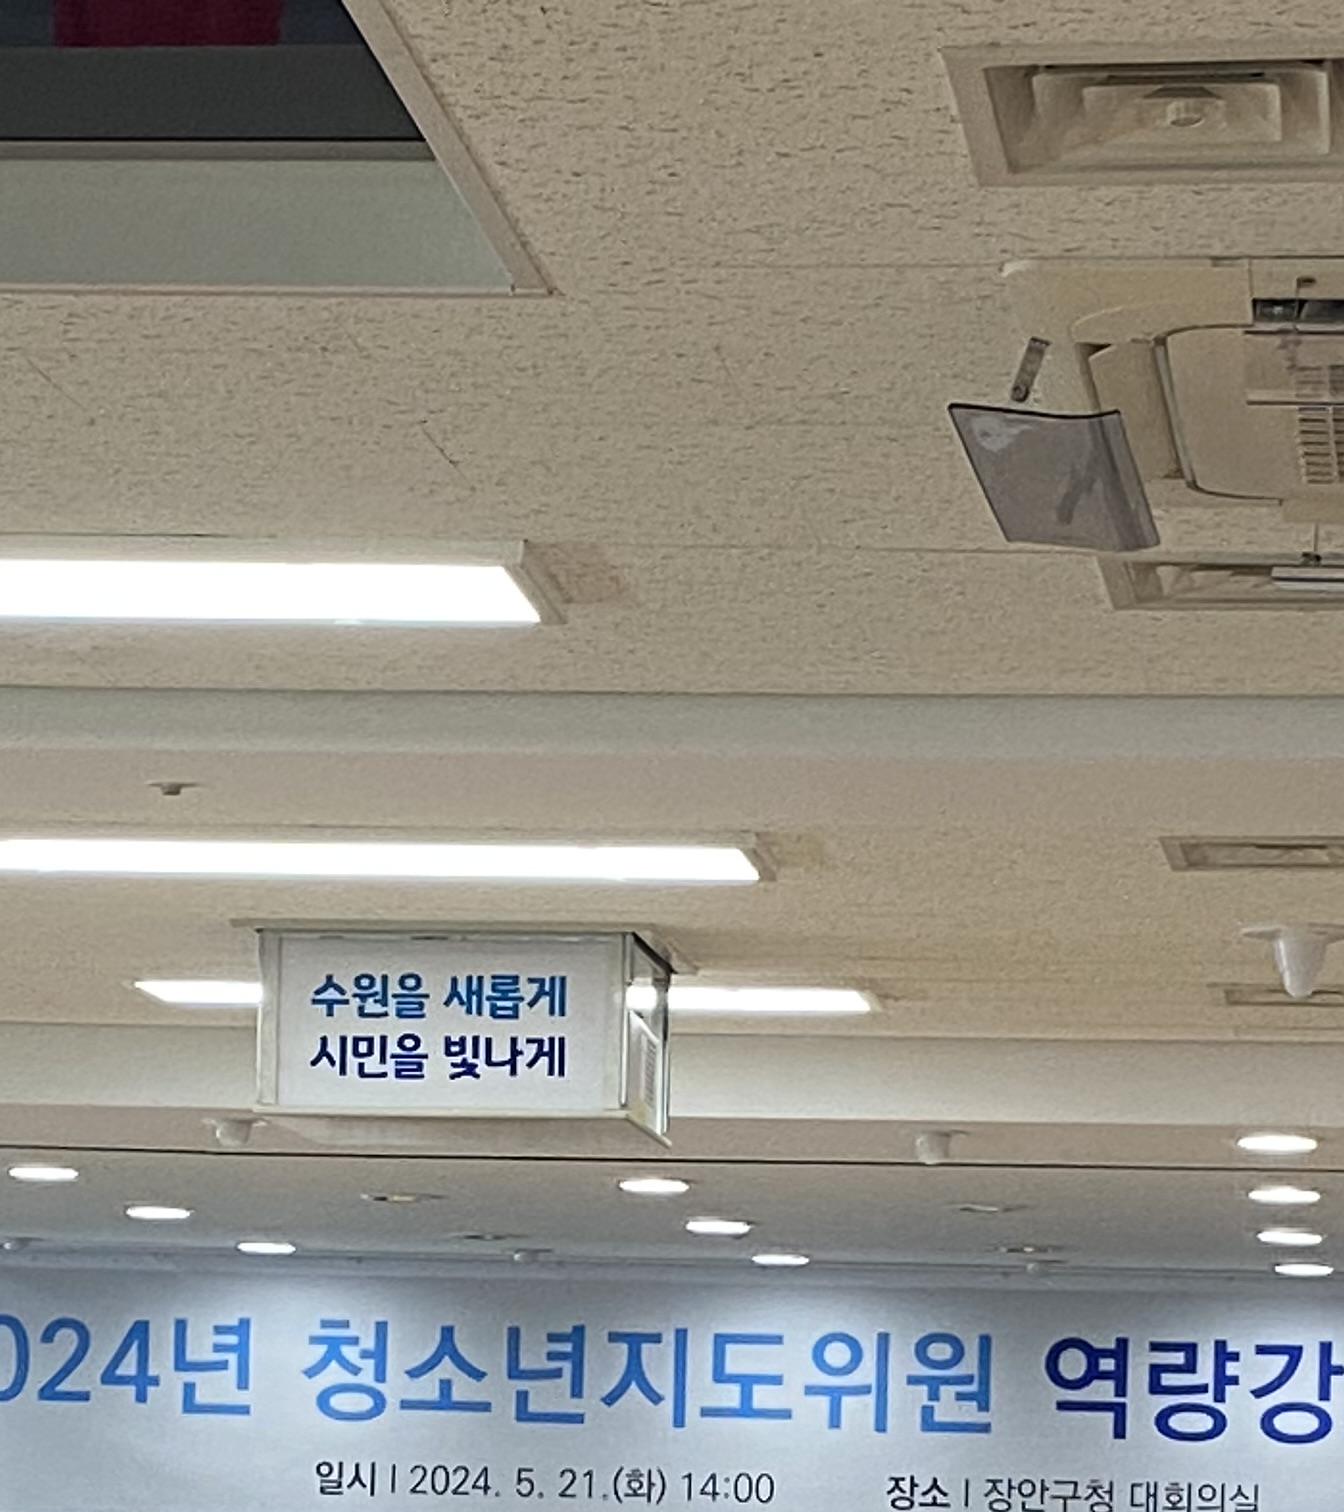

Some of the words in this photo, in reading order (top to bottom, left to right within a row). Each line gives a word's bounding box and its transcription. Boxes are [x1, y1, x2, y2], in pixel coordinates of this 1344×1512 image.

[311, 972, 431, 1019] 수원을
[442, 974, 567, 1020] 새롭게
[309, 1033, 429, 1080] 시민을
[443, 1035, 566, 1081] 빛나게
[300, 1318, 994, 1435] 청소년지도위원
[315, 1461, 377, 1497] 일시
[409, 1464, 501, 1497] 2024.
[515, 1467, 545, 1499] 5.
[558, 1467, 667, 1505] 21.(화)
[681, 1472, 776, 1504] 14:00
[886, 1474, 951, 1511] 장소
